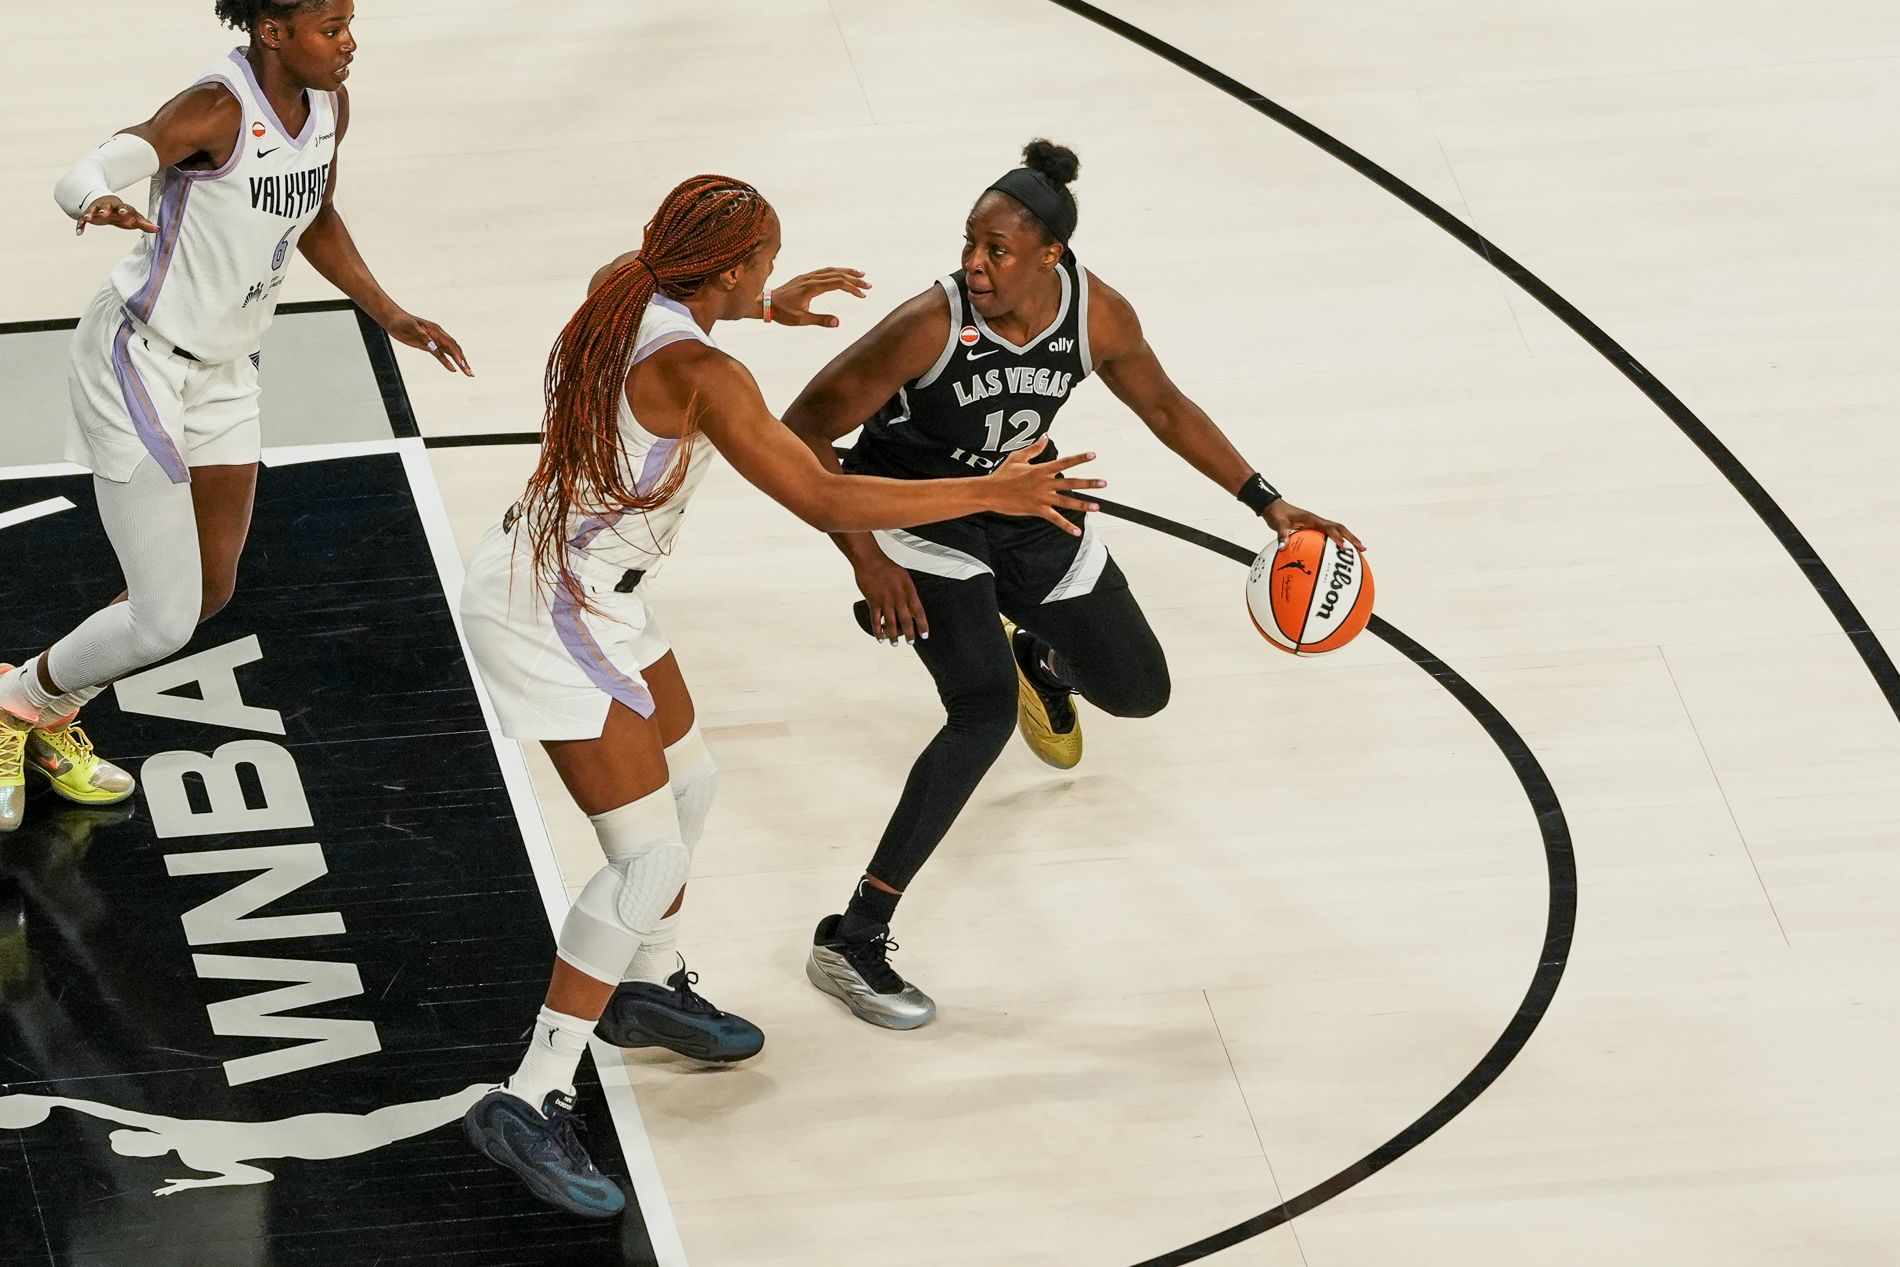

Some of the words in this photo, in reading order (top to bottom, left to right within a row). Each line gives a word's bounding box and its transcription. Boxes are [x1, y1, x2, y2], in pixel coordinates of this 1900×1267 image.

[249, 163, 329, 219] VALKYRIE
[271, 225, 297, 271] 6
[1048, 337, 1075, 354] ally
[952, 369, 1003, 407] LAS
[1004, 366, 1073, 398] VEGAS
[981, 409, 1041, 453] 12
[1315, 544, 1356, 620] Wilson
[113, 632, 382, 1088] WNBA
